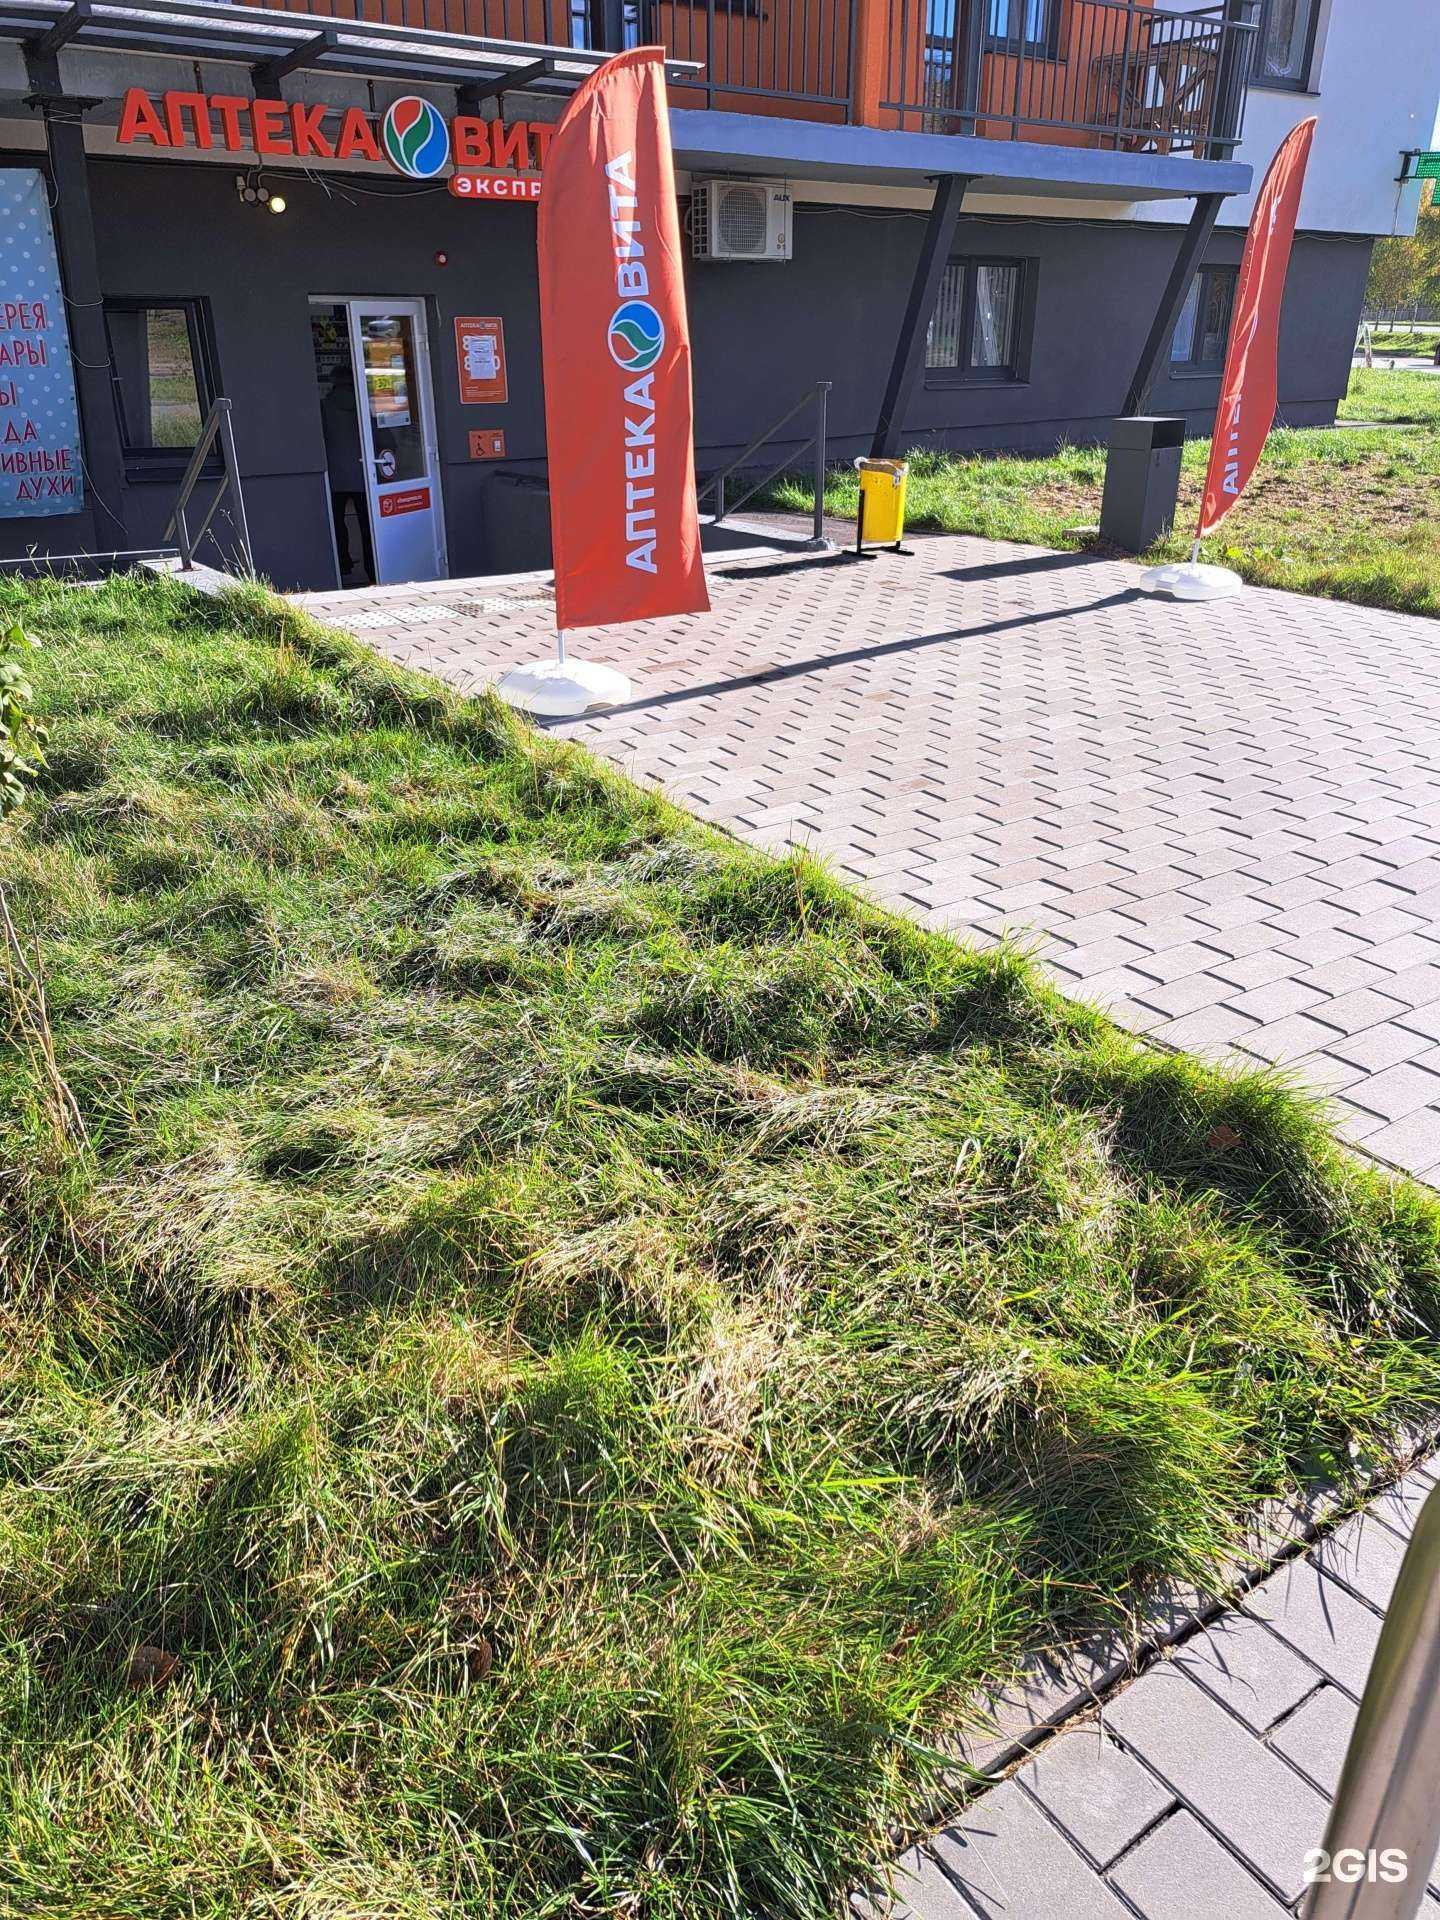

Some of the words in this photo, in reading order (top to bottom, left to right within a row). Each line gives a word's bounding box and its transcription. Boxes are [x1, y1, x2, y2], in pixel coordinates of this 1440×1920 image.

[117, 87, 381, 161] АПТЕКА
[605, 149, 650, 298] ВИТА
[16, 475, 74, 499] ДУХИ
[624, 371, 658, 574] АПТЕКА
